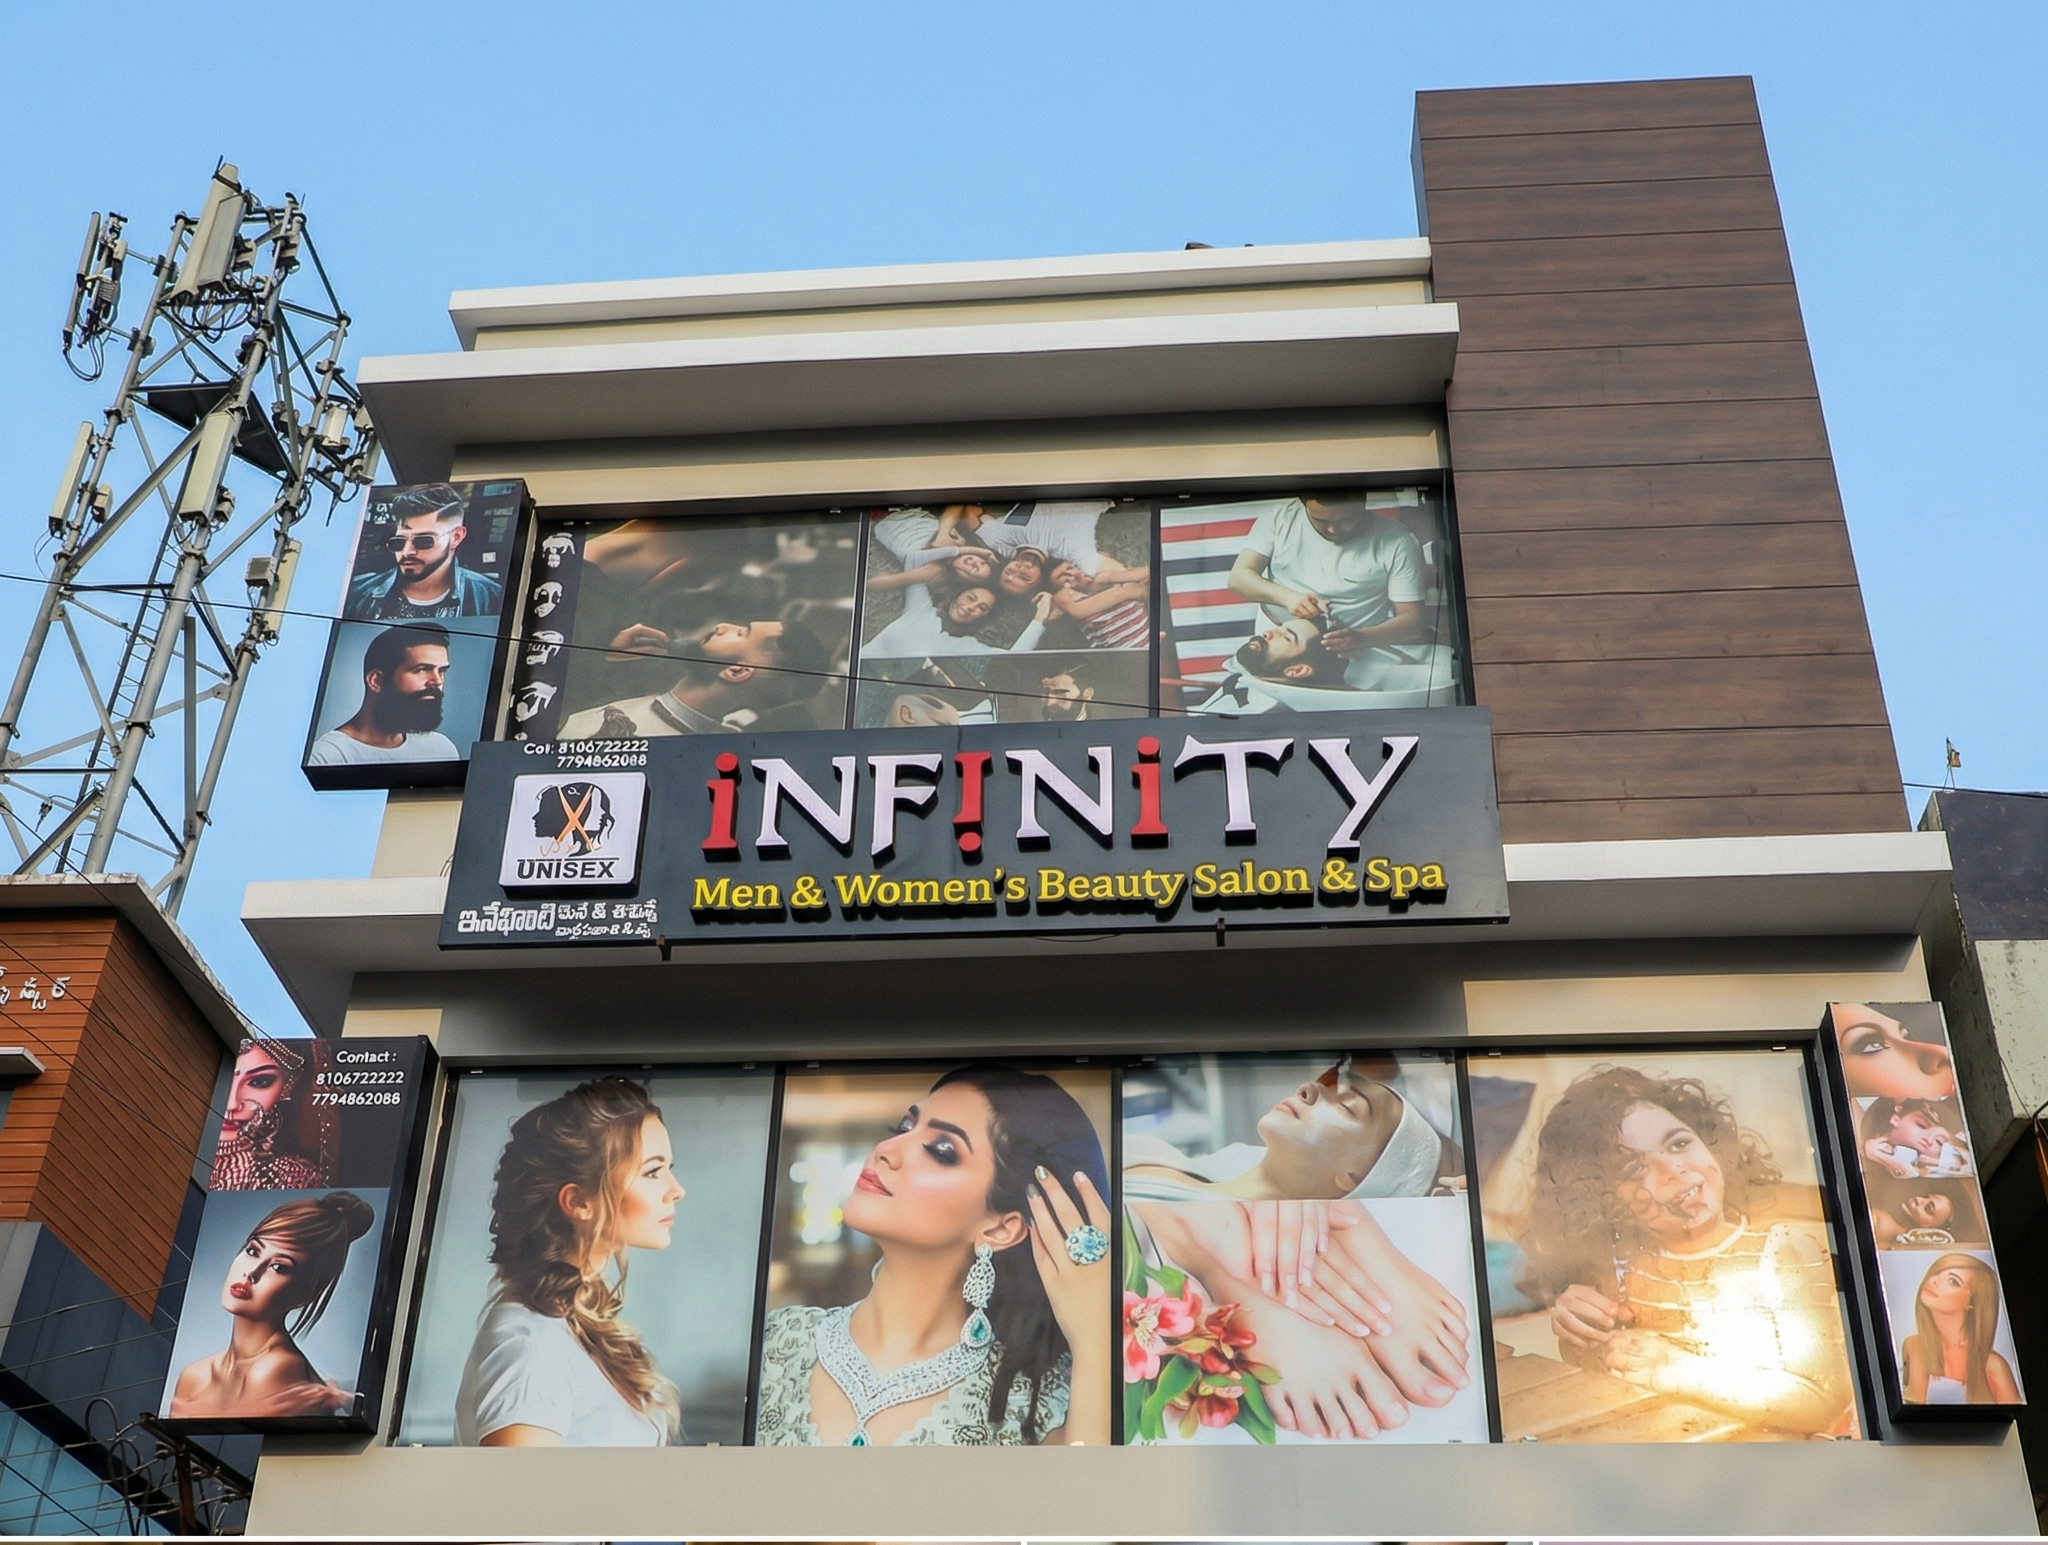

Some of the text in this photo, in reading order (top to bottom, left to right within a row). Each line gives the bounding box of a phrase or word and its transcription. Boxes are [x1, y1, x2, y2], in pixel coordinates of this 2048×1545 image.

[557, 754, 647, 768] 7794862088
[517, 861, 615, 879] UNISEX
[692, 857, 1447, 908] Men & Women's Beauty Salon & Spa
[315, 1071, 404, 1085] 8106722222
[312, 1092, 401, 1106] 7794862088
